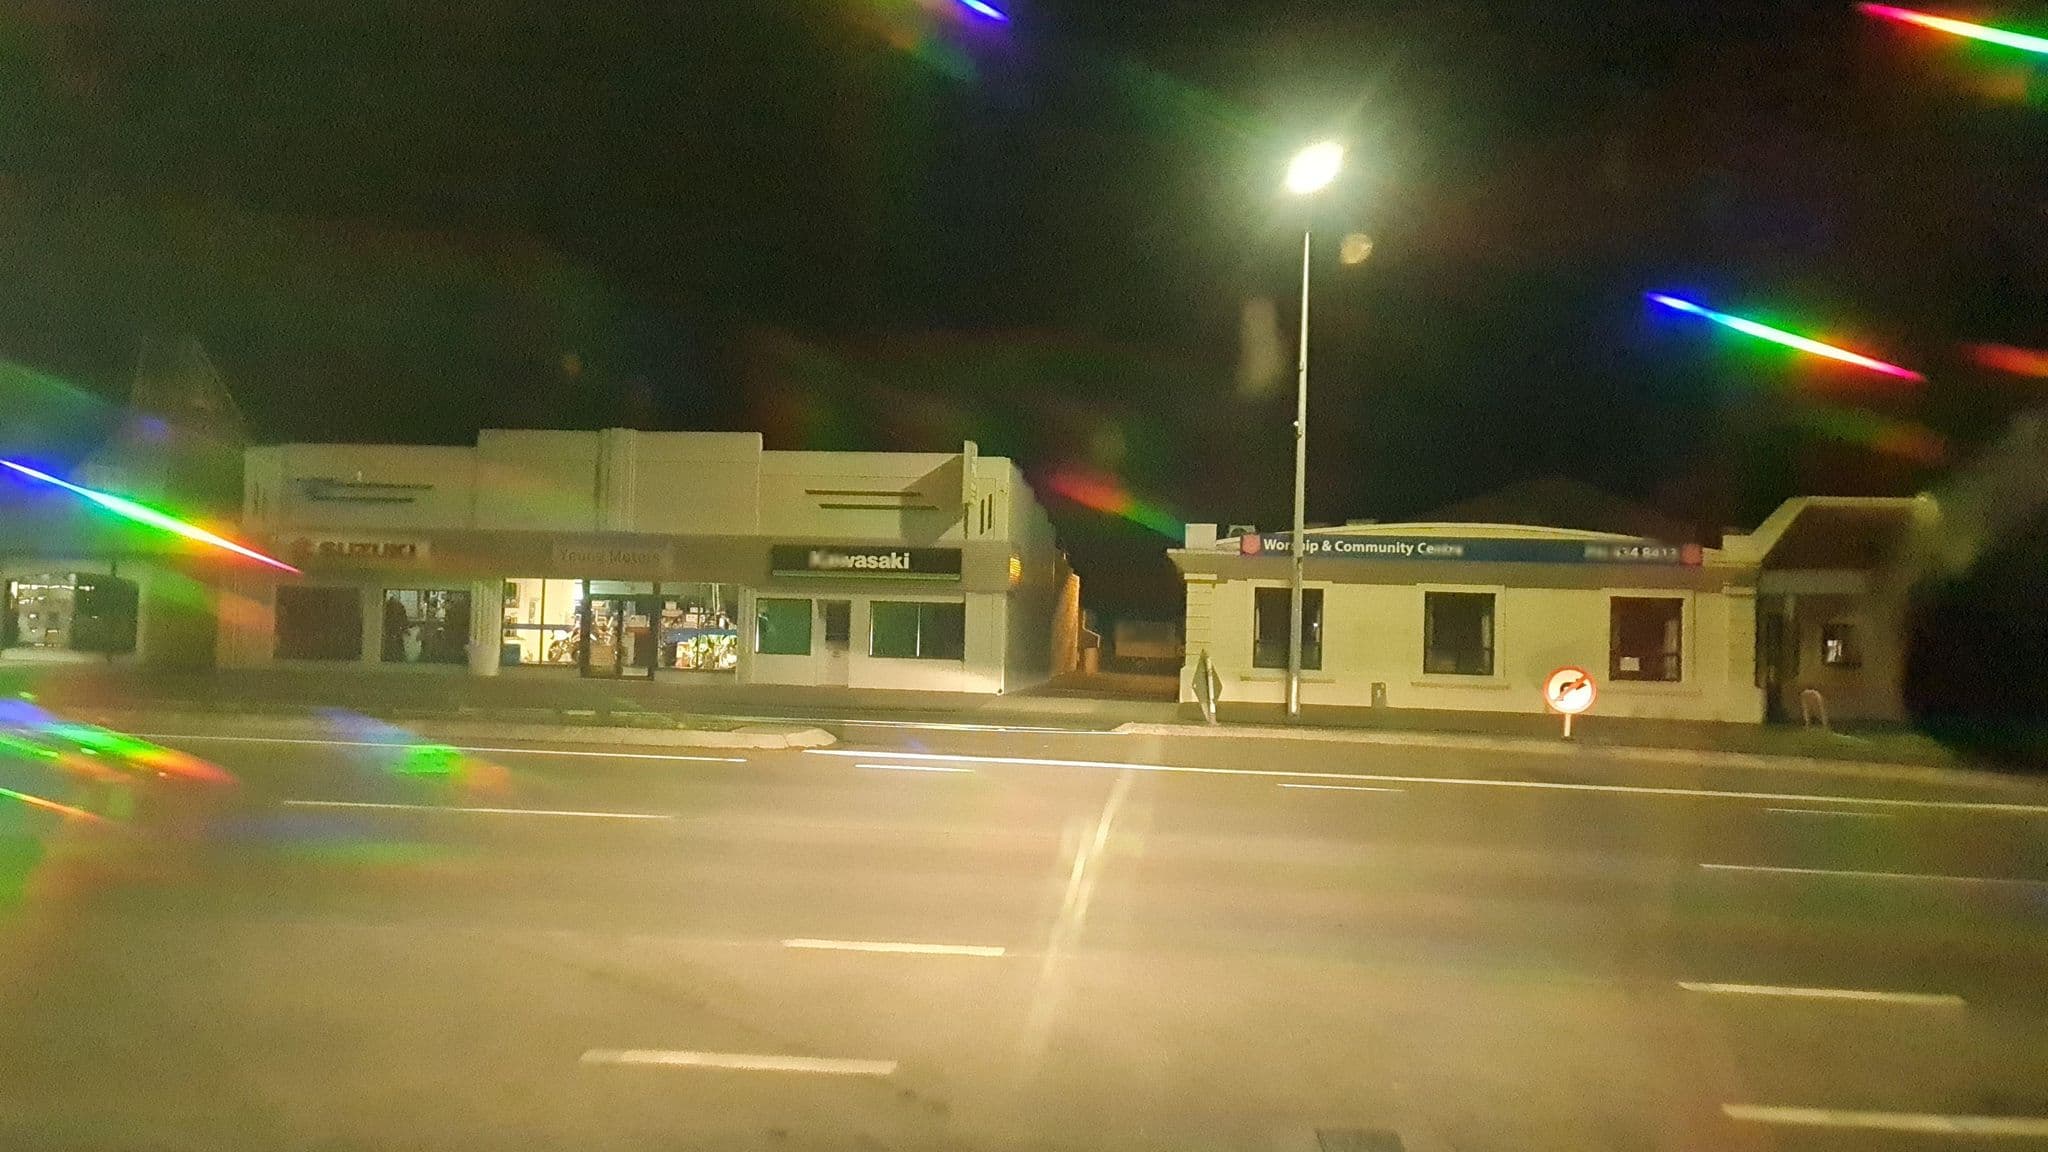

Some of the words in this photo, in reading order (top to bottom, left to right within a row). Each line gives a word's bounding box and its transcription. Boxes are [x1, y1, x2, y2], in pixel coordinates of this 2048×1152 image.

[319, 541, 416, 557] SUZUKI
[1263, 538, 1318, 554] Worip
[1322, 540, 1332, 552] &
[1335, 540, 1414, 557] Community
[810, 551, 910, 569] wasaki
